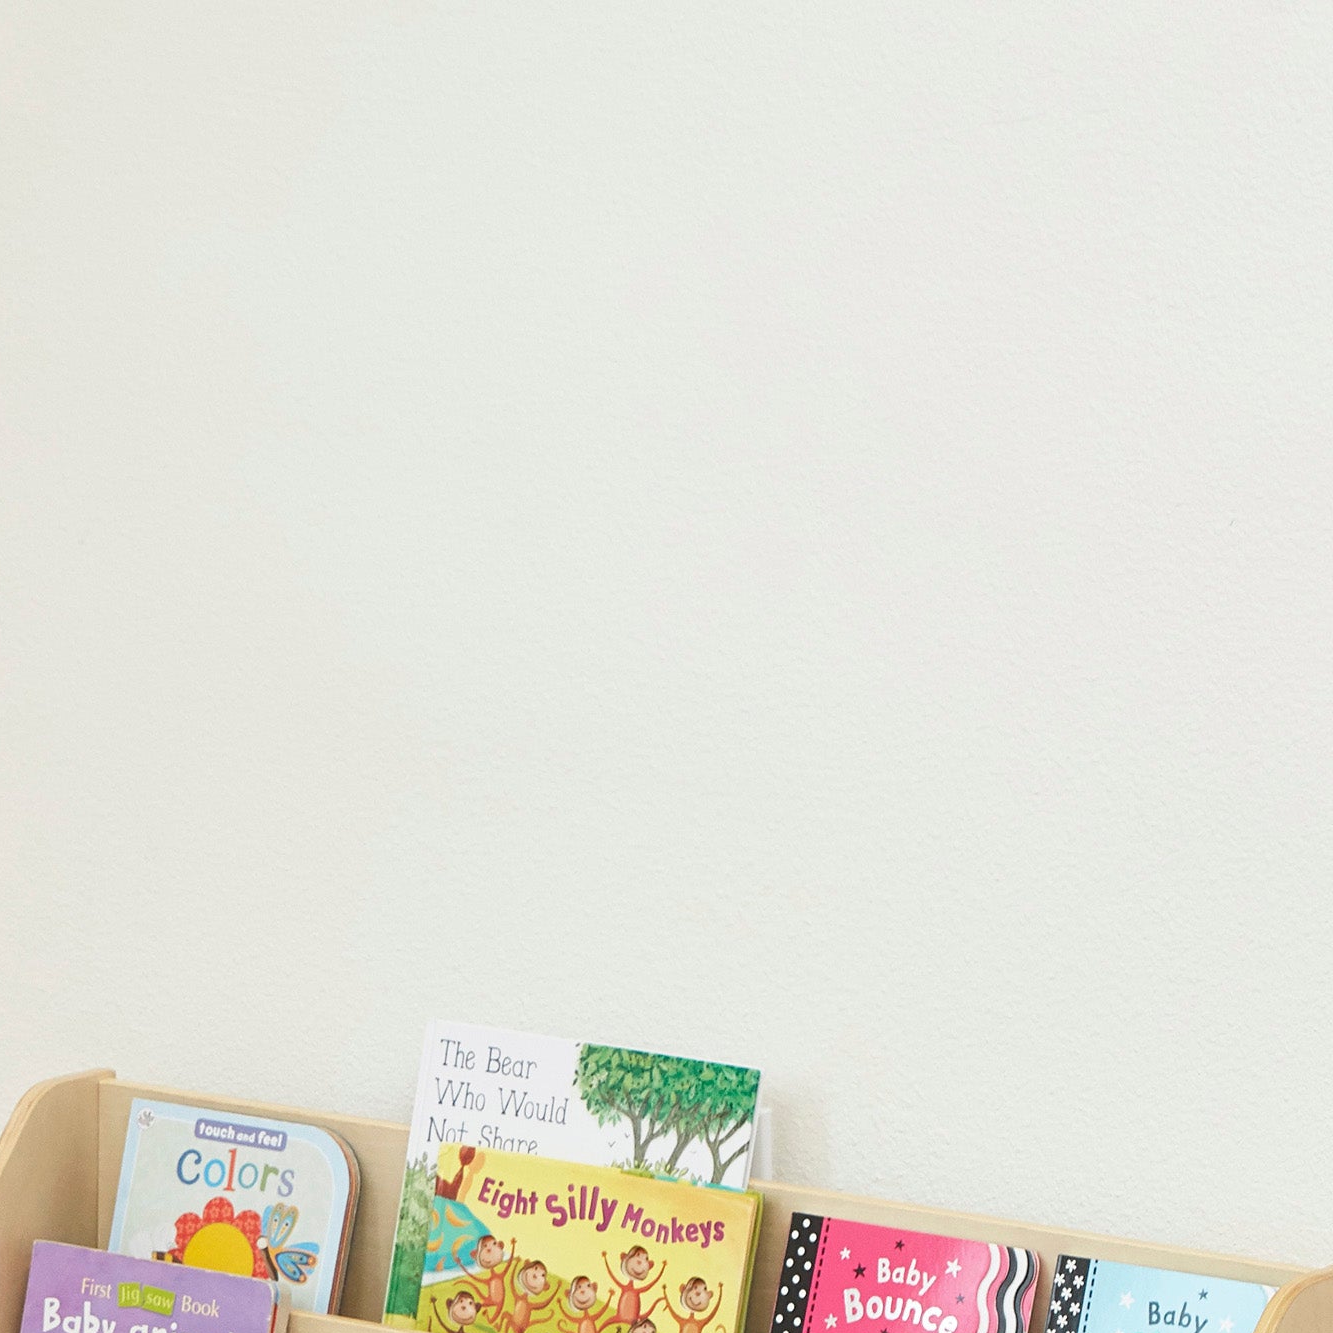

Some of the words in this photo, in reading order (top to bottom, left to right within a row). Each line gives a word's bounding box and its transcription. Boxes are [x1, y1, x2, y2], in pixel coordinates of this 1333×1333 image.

[440, 1039, 475, 1070] The
[486, 1046, 537, 1079] Bear
[435, 1077, 485, 1111] Who
[498, 1087, 569, 1125] Would
[199, 1122, 235, 1139] touch
[236, 1132, 255, 1143] and
[258, 1131, 282, 1147] feel
[426, 1117, 469, 1144] Not
[477, 1125, 539, 1156] Share
[177, 1148, 295, 1197] Colors
[477, 1177, 539, 1219] Eight
[545, 1183, 618, 1233] Silly
[621, 1203, 726, 1249] Monkeys
[877, 1257, 937, 1296] Baby
[82, 1278, 111, 1299] First
[181, 1295, 220, 1318] Book
